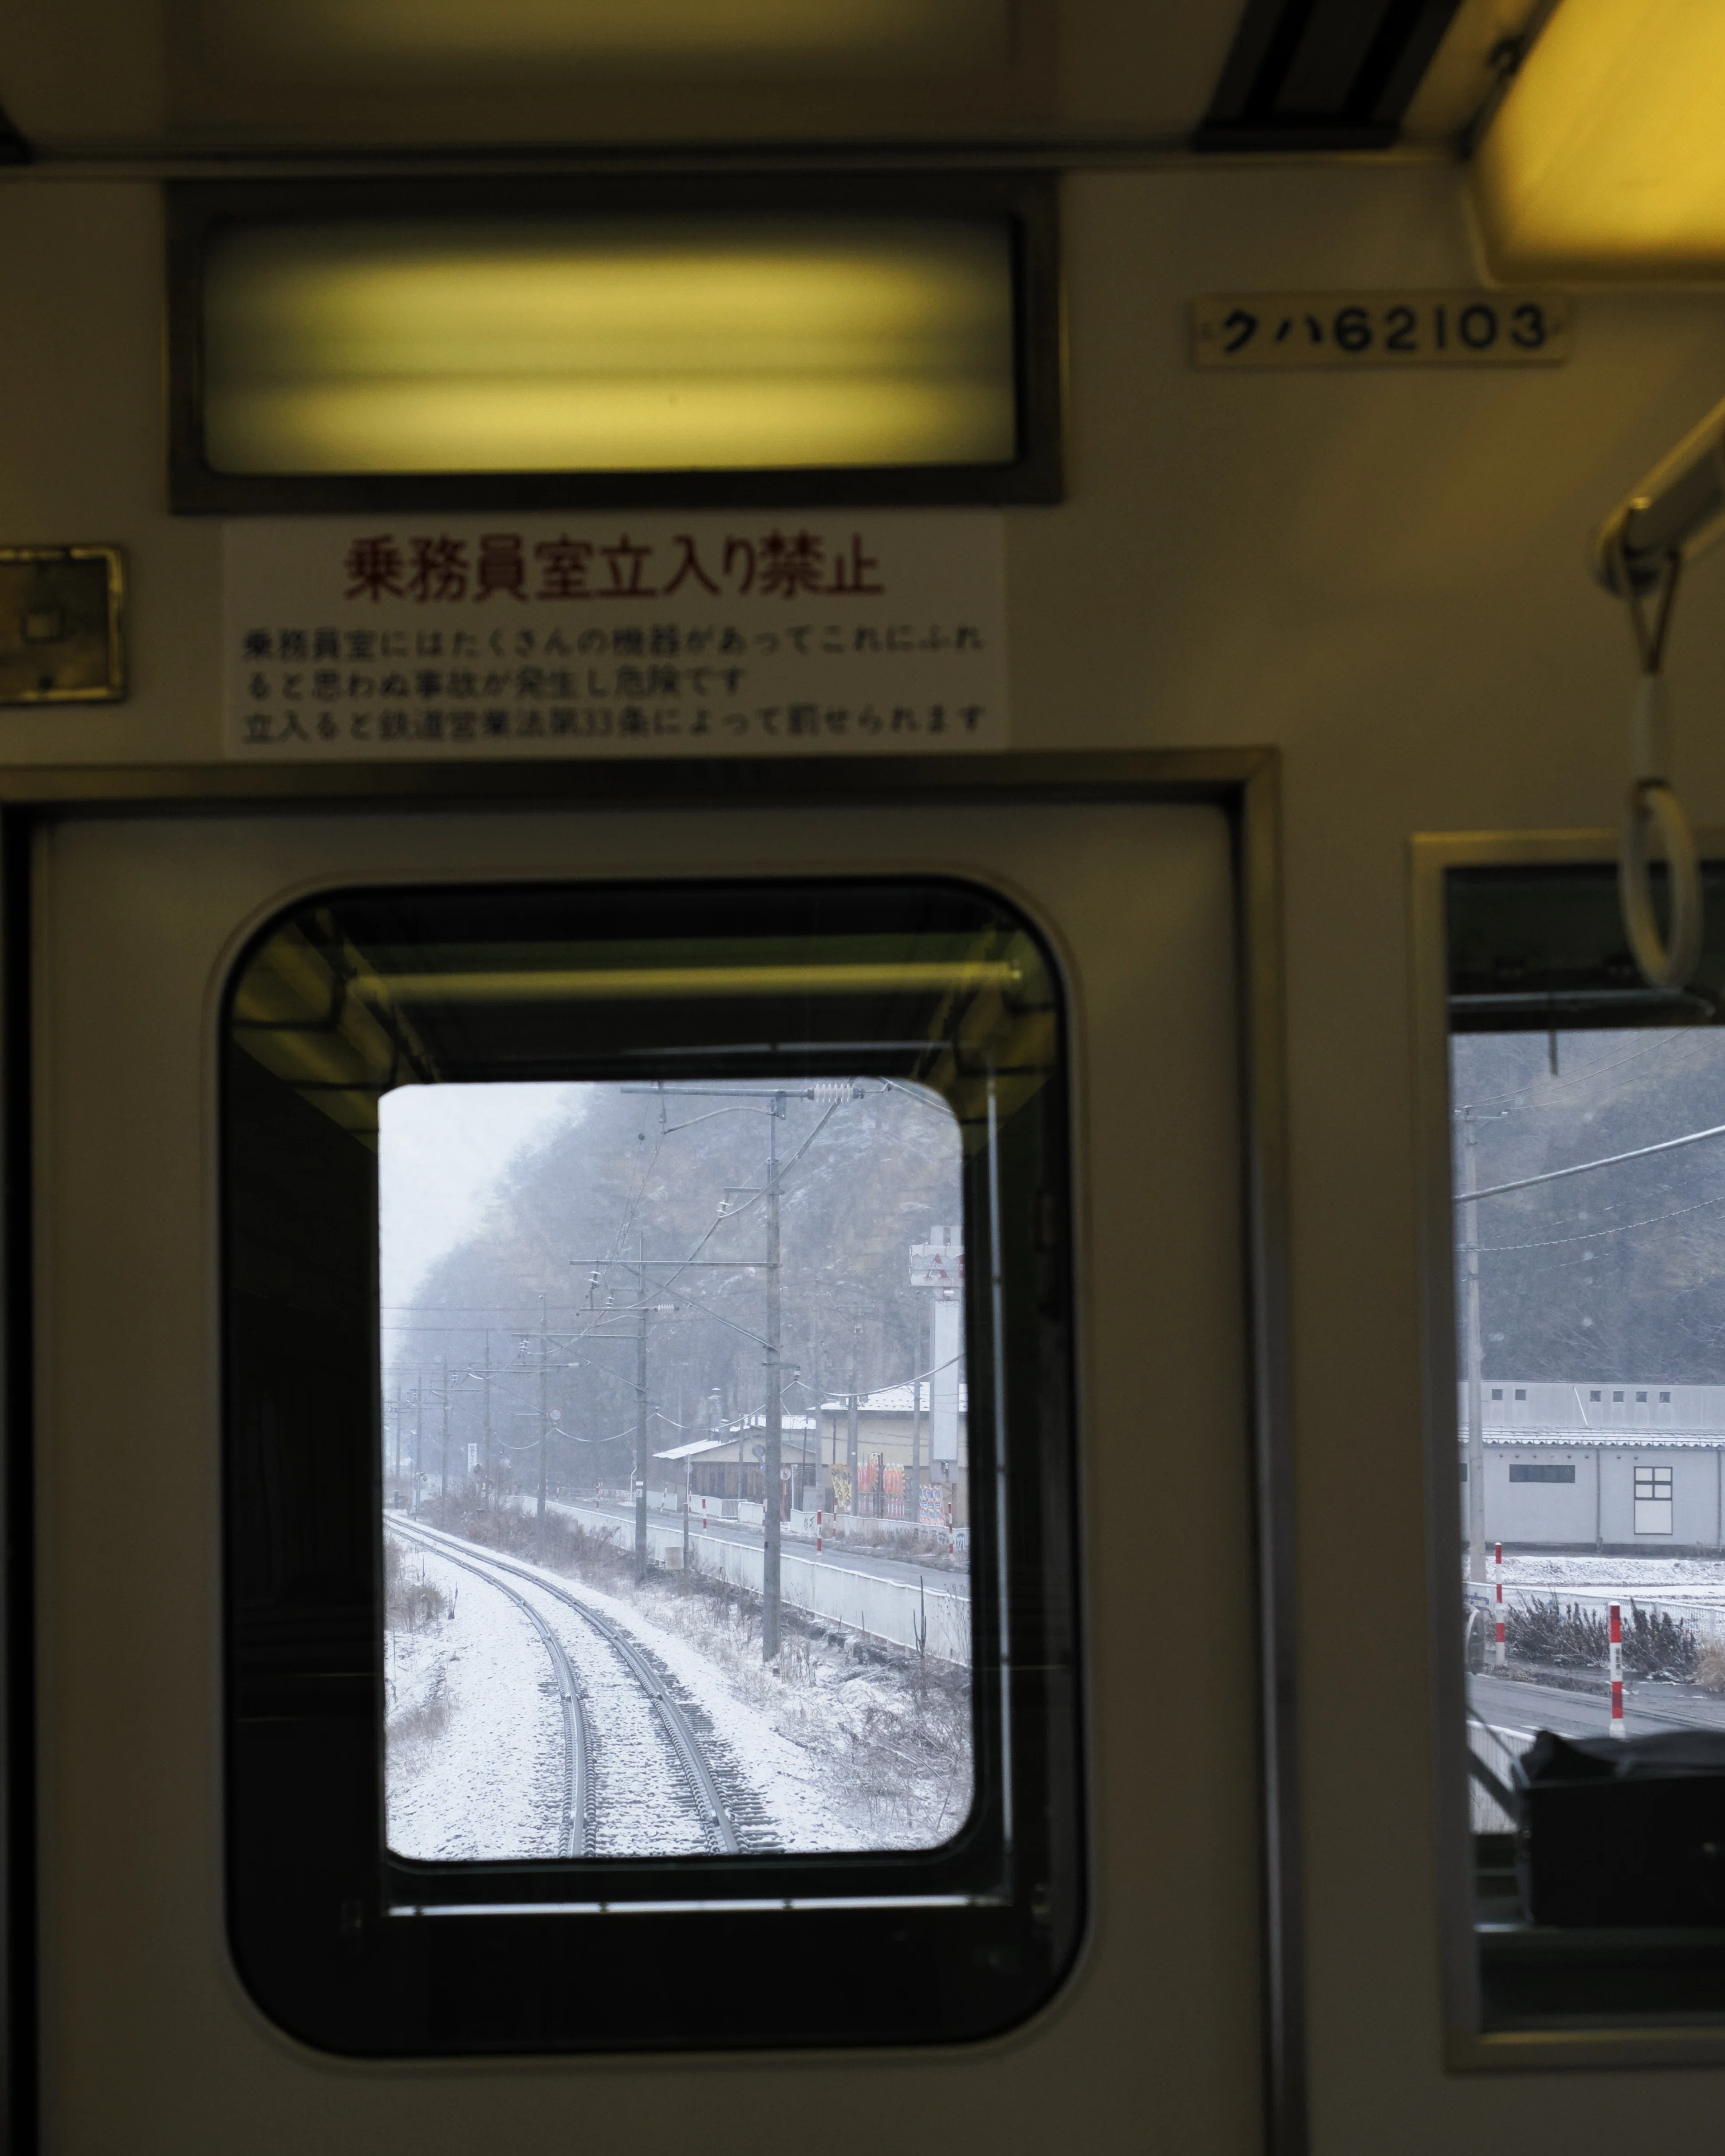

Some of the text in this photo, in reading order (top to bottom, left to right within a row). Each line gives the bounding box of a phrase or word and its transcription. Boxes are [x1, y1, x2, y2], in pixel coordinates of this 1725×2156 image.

[1222, 302, 1548, 354] クハ62103
[343, 528, 885, 604] 乗務員室立入り禁止
[242, 622, 988, 661] 乗務員室にはたくさんの機器があってこれにふれ
[248, 665, 747, 701] ると思わぬ事故が発生し危険です
